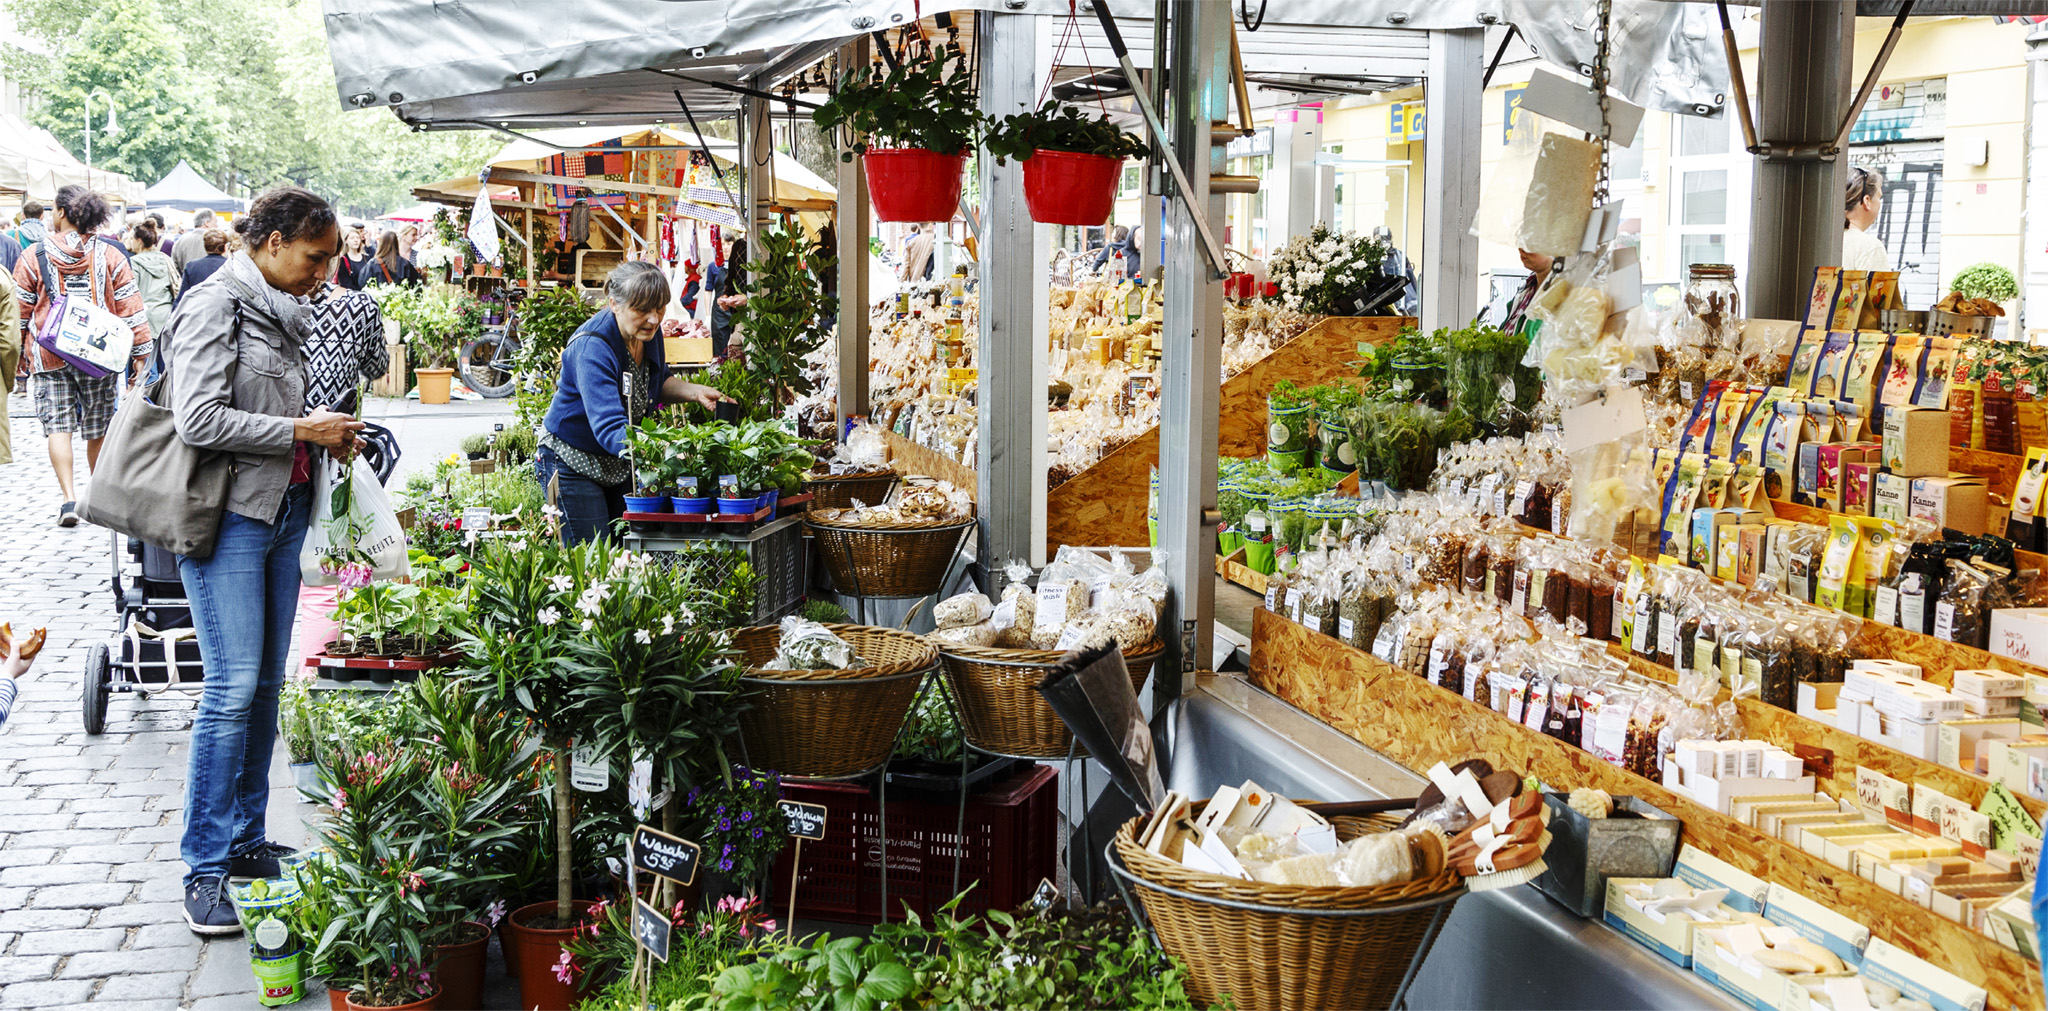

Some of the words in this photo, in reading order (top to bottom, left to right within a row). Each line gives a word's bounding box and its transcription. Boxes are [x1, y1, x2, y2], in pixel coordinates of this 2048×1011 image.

[1884, 421, 1900, 433] Kanne
[1876, 487, 1899, 500] Kanne
[1912, 496, 1937, 508] Kanne
[366, 535, 395, 556] BELITZ
[2006, 639, 2031, 660] Midi
[639, 832, 694, 862] Wasabi
[863, 836, 922, 850] Pfand-/Lekiste
[896, 855, 921, 864] Hamburg
